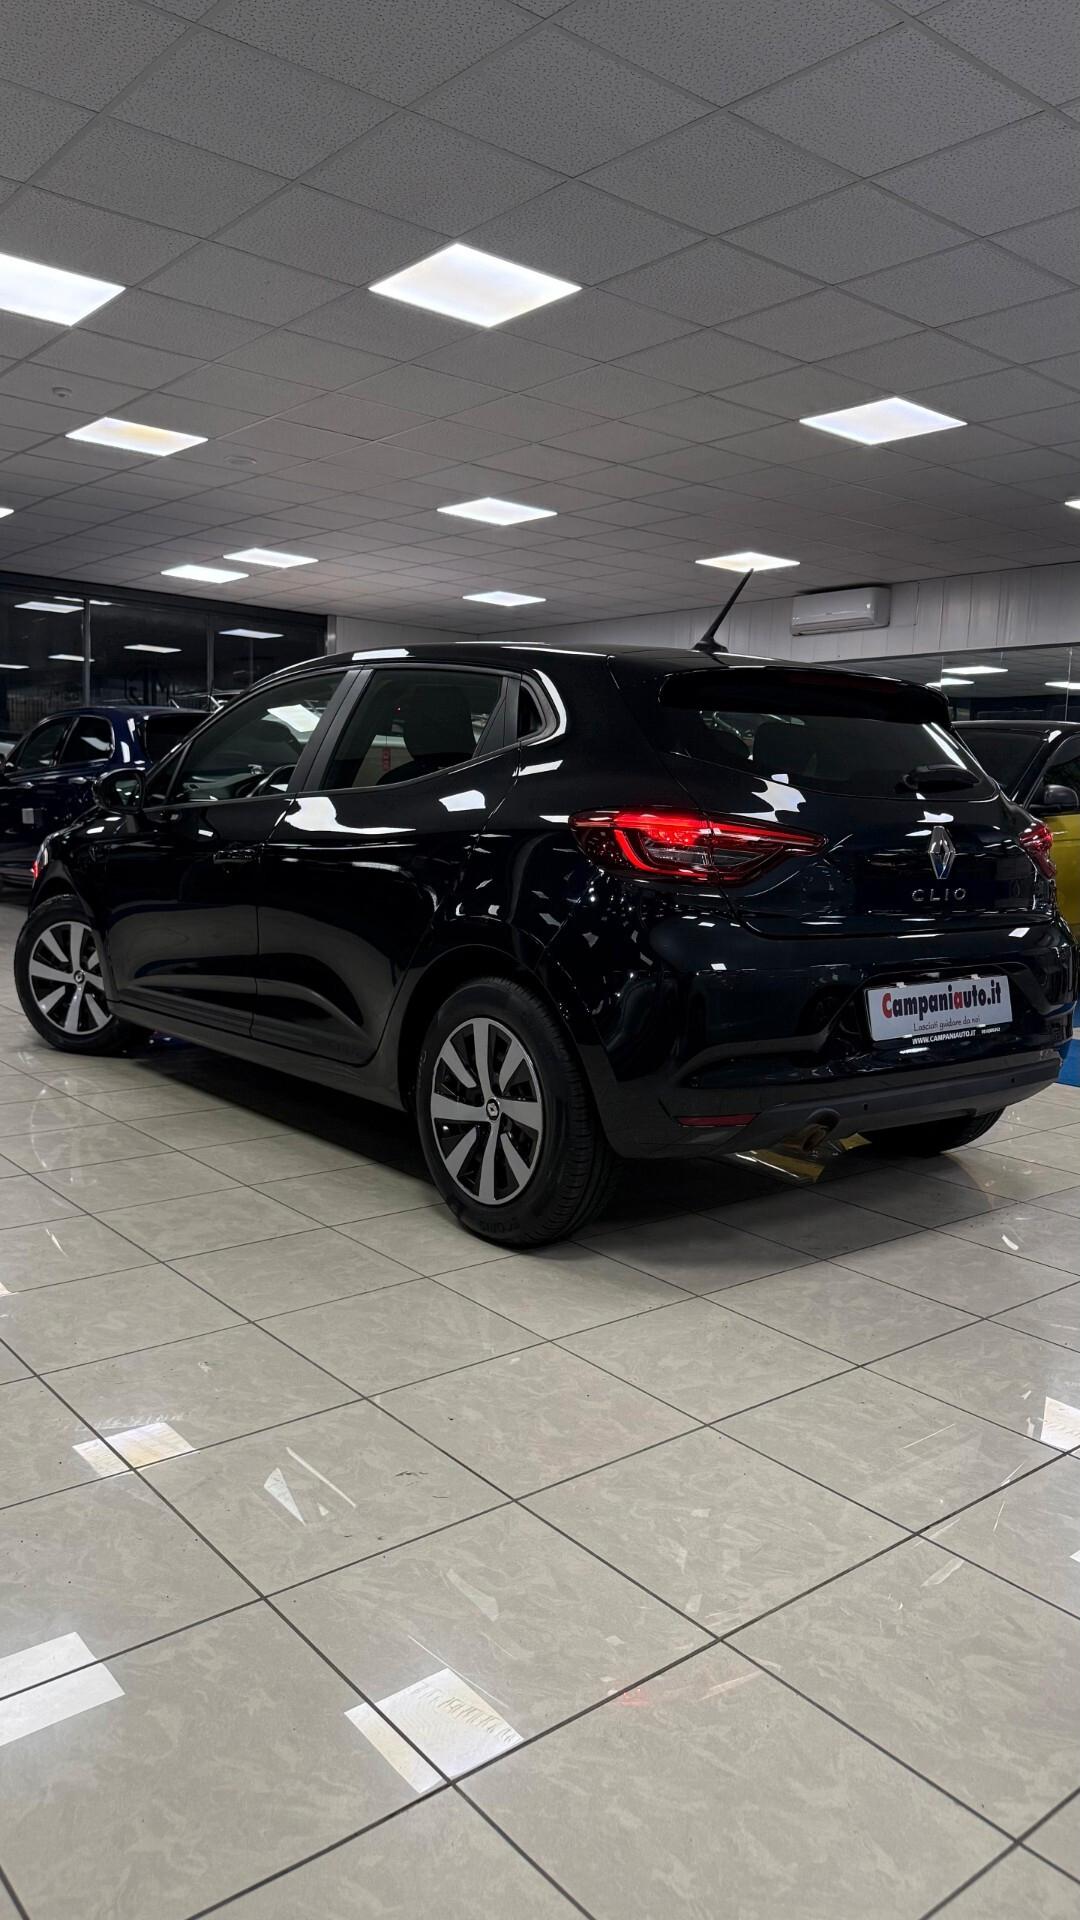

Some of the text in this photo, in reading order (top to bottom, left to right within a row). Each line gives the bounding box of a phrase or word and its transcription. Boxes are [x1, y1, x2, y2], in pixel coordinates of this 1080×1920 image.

[911, 888, 967, 901] CLIO
[882, 979, 1001, 1021] Campaniauto.it
[913, 1020, 939, 1032] Lasciati
[940, 1017, 962, 1031] guidare
[962, 1015, 971, 1025] da
[912, 1029, 976, 1045] WWW.CAMPANIAUTO.IT
